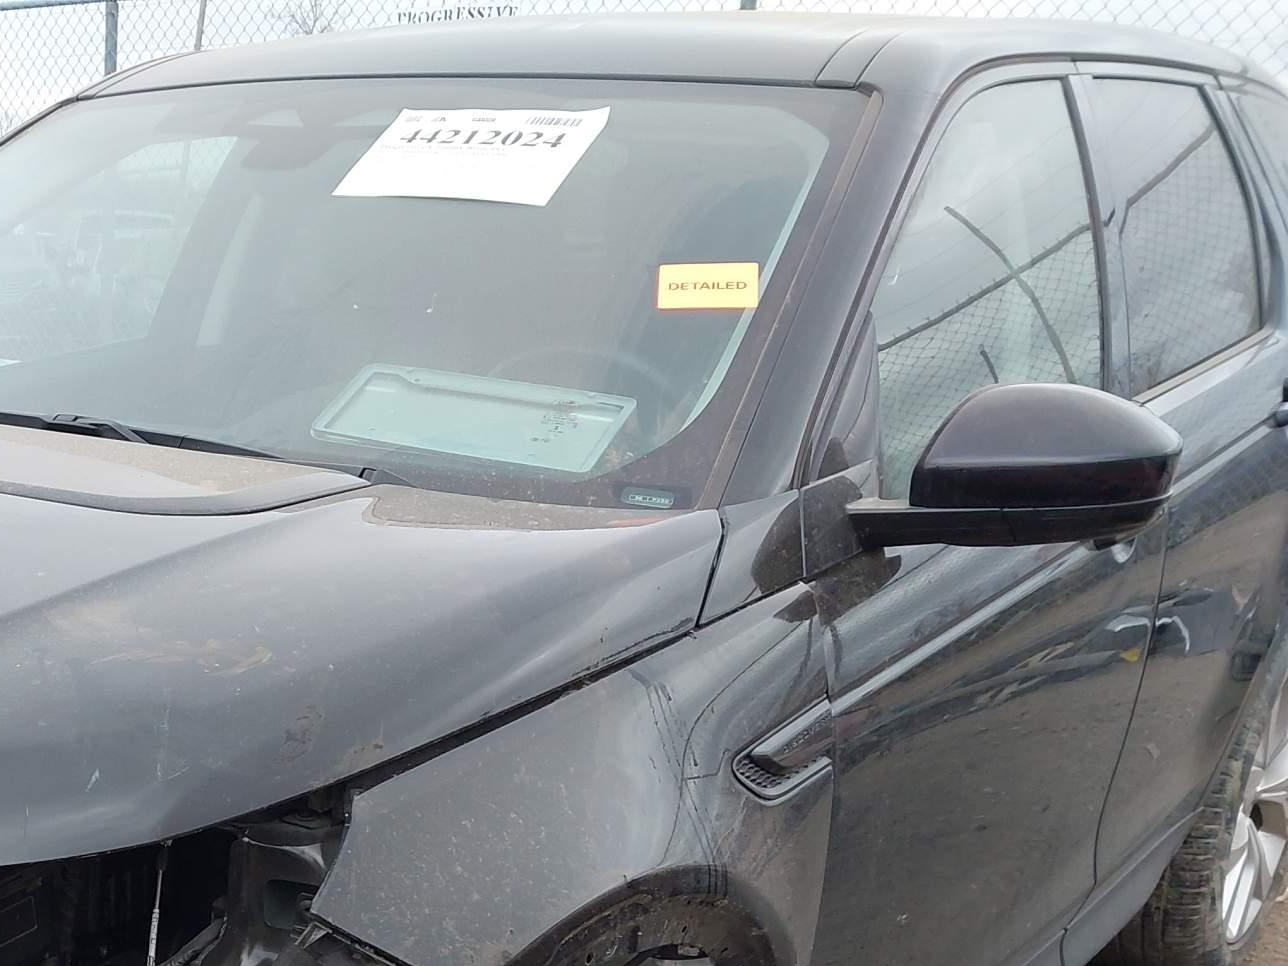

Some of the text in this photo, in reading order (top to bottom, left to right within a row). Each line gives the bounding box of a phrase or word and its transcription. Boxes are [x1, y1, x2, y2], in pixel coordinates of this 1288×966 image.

[396, 5, 519, 25] PROGRESSIVE
[400, 128, 566, 149] 44212024
[668, 281, 748, 291] DETAILED
